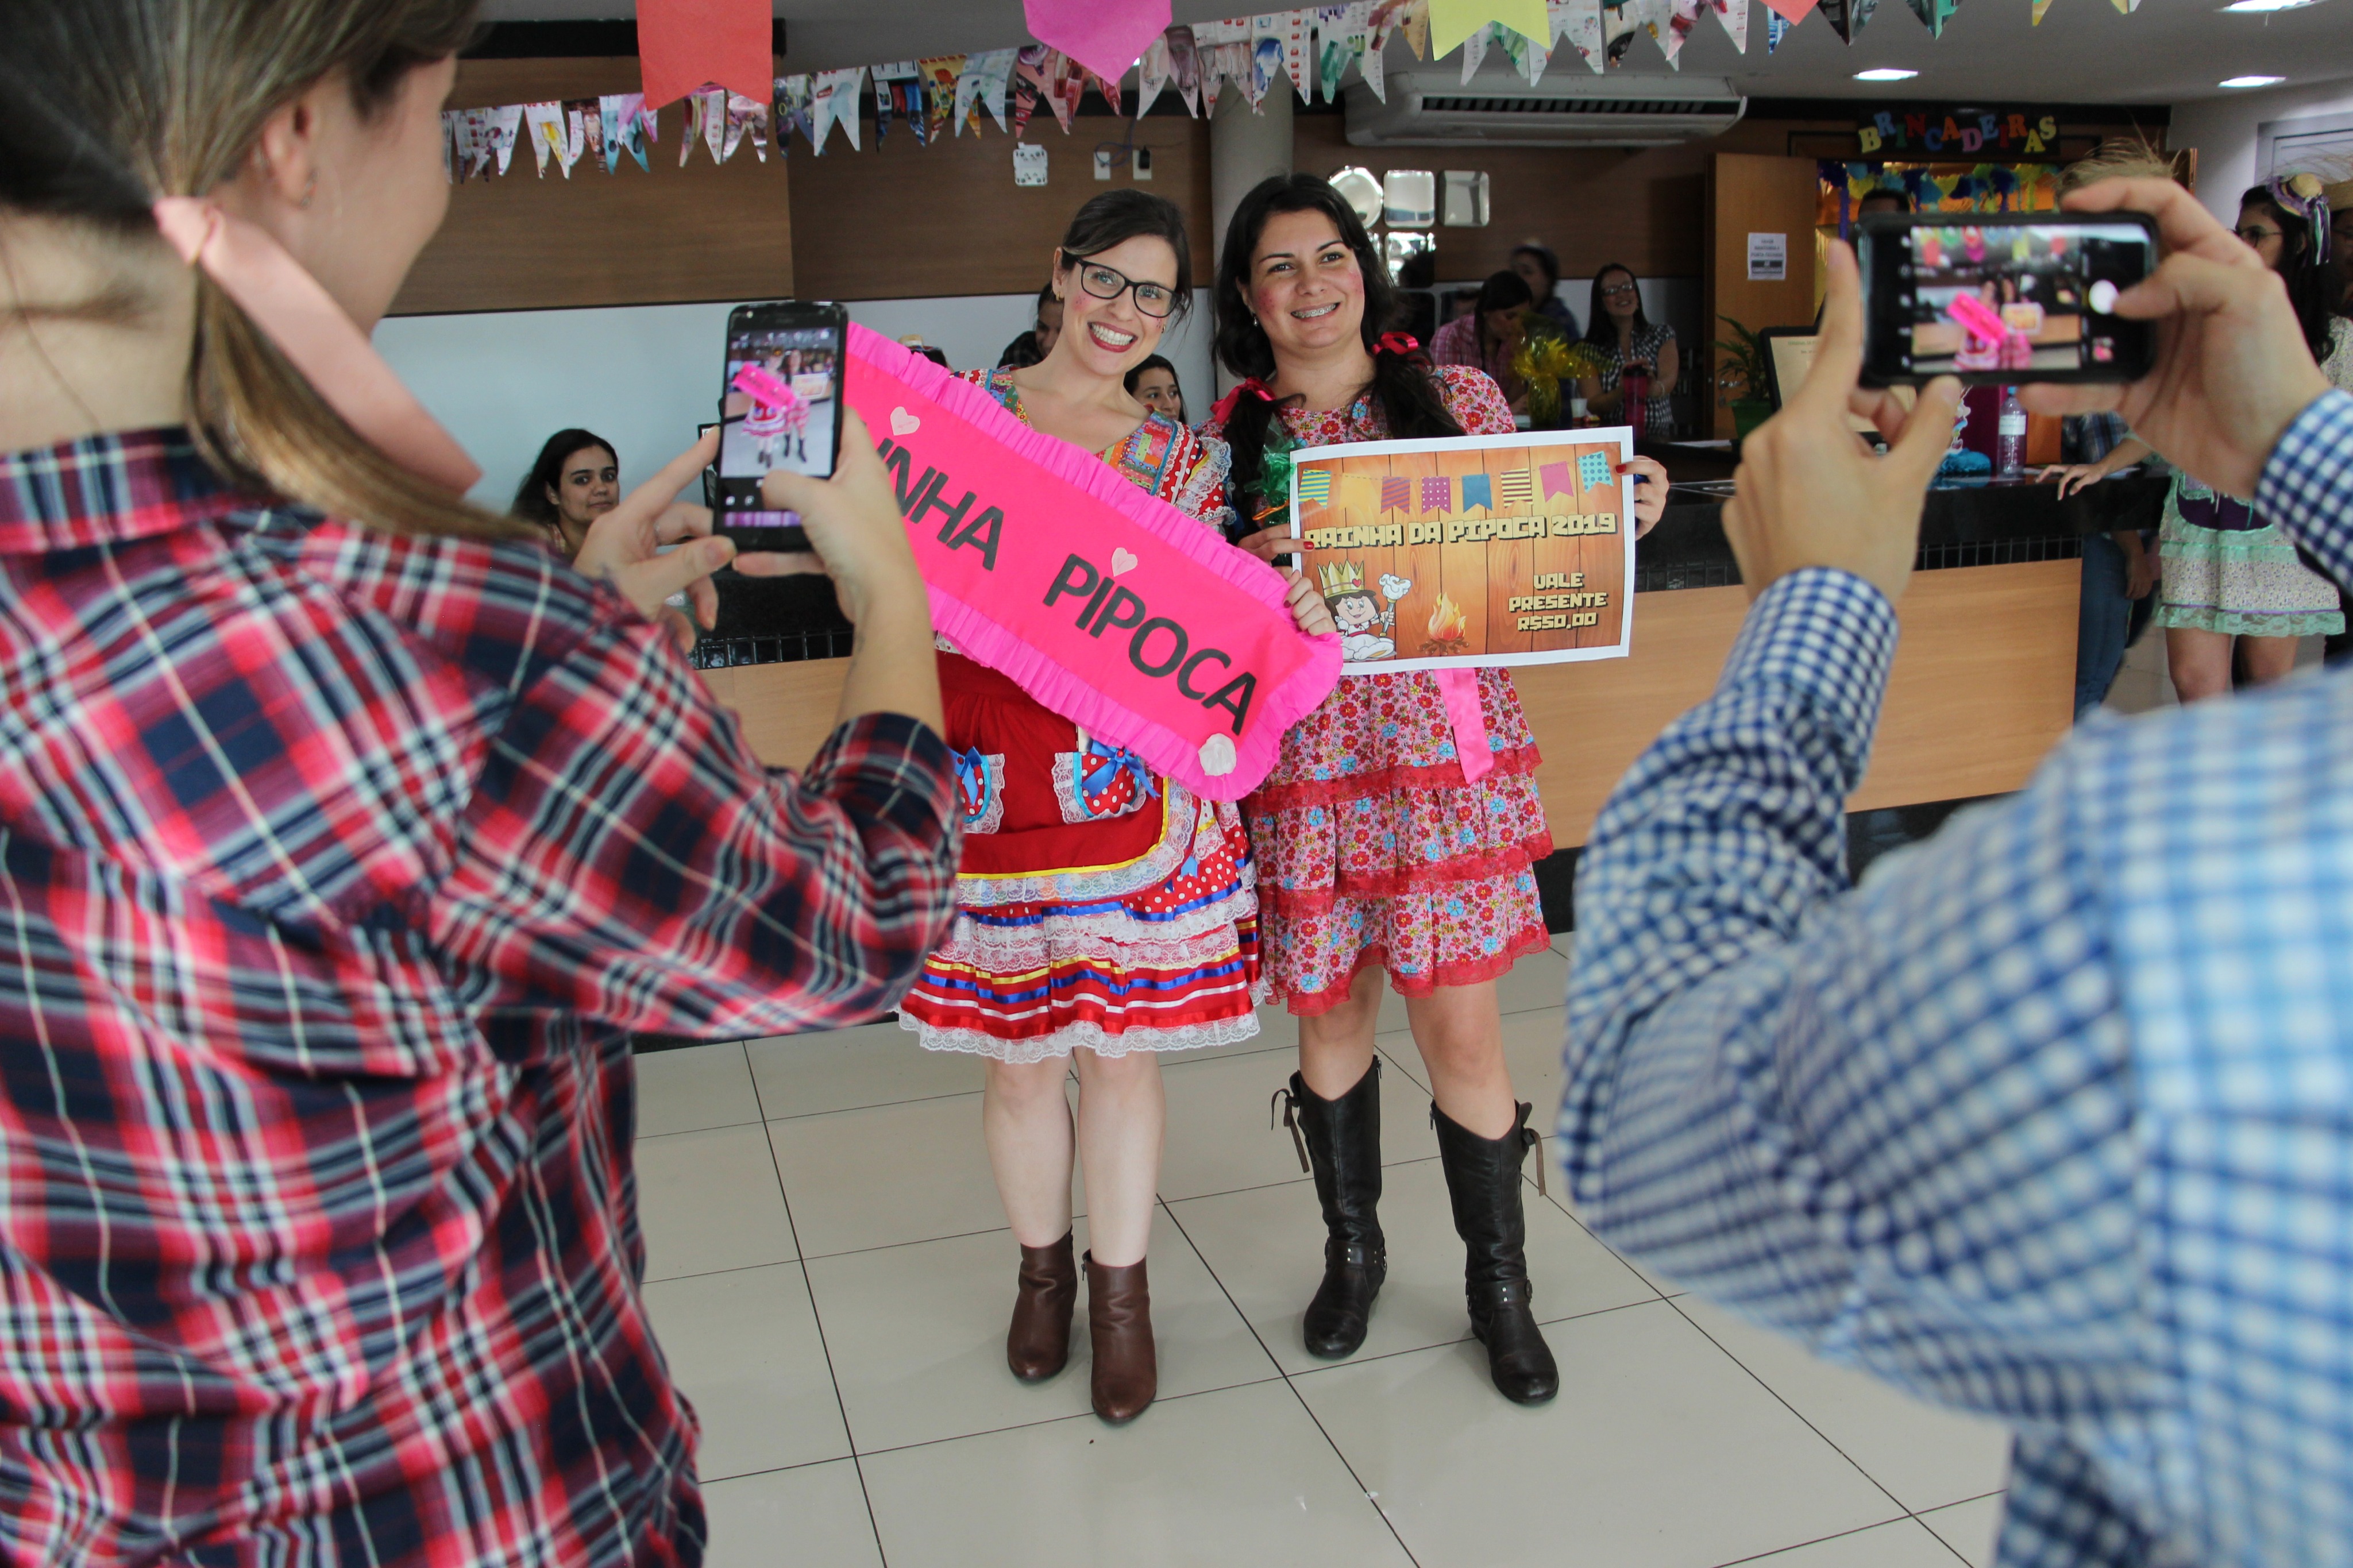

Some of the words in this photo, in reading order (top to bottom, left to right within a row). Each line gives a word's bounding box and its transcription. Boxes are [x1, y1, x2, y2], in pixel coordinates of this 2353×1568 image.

[1859, 111, 2057, 153] BRINCADEIRAS
[1305, 524, 1403, 549] RAINHA
[1409, 521, 1443, 545] DA
[1448, 515, 1546, 543] PIPOCA
[1551, 513, 1617, 536] 2019
[1533, 573, 1584, 590] VALE
[1509, 592, 1608, 612] PRESENTE
[1517, 612, 1598, 631] R$50,00
[1043, 553, 1256, 735] PIPOCA
